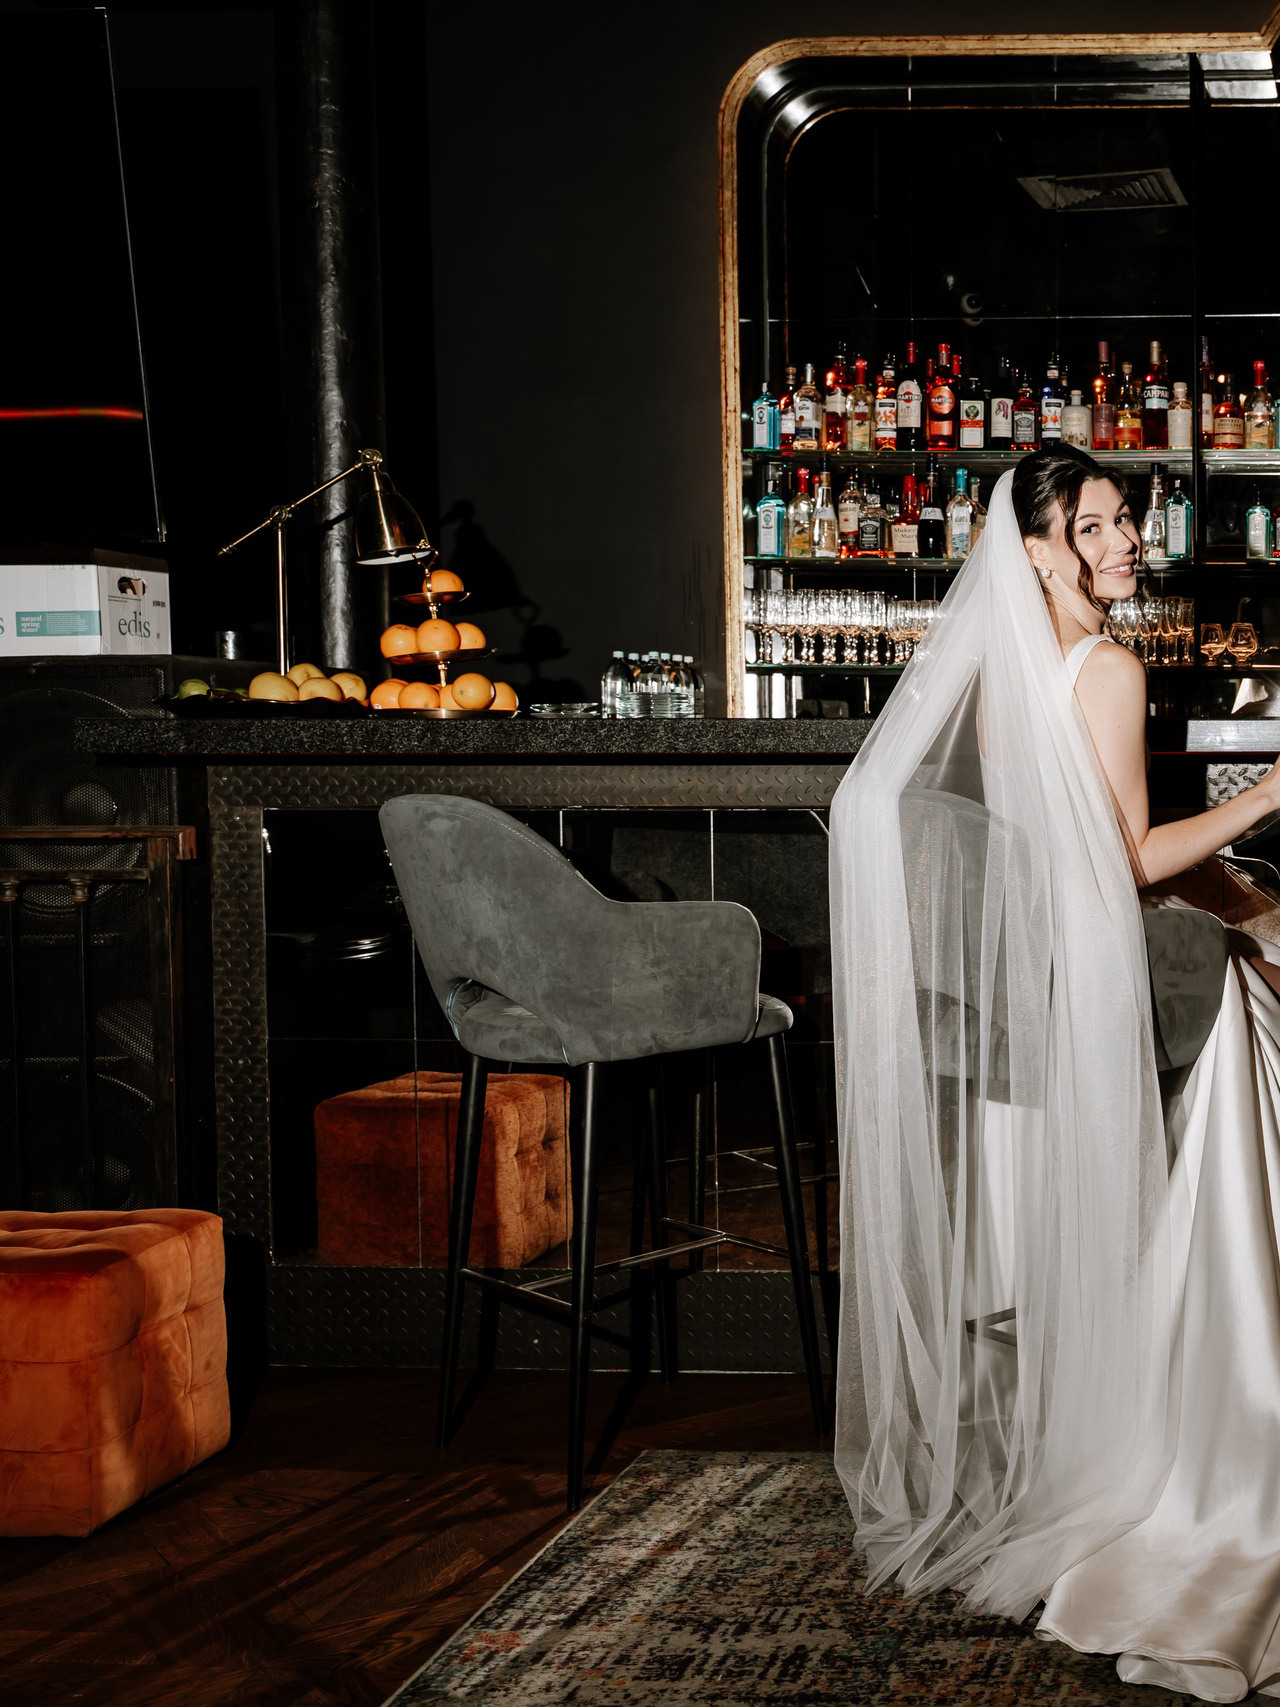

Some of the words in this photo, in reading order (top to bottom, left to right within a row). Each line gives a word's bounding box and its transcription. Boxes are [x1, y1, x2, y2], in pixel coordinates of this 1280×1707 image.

[1144, 389, 1169, 399] CAMPAR
[20, 614, 42, 622] natural
[21, 621, 41, 629] spring
[118, 610, 151, 638] edis
